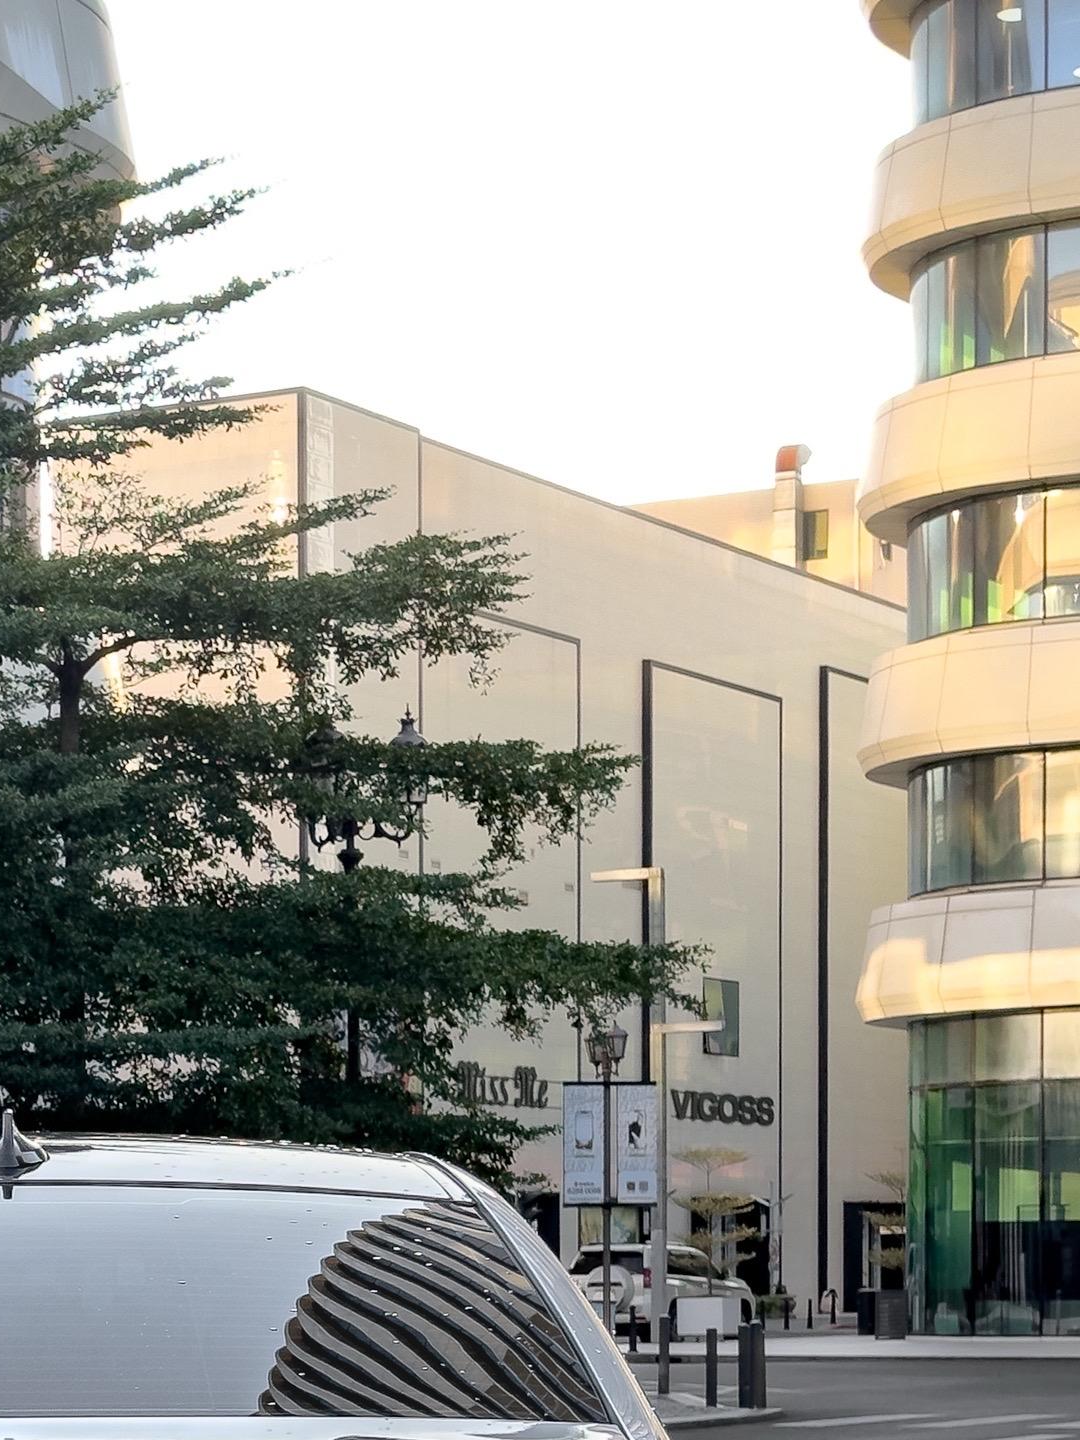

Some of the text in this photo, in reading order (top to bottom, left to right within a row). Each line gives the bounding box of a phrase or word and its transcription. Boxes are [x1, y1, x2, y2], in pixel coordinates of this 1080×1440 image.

[457, 1060, 548, 1109] Miss Me
[670, 1089, 775, 1126] VIGOSS
